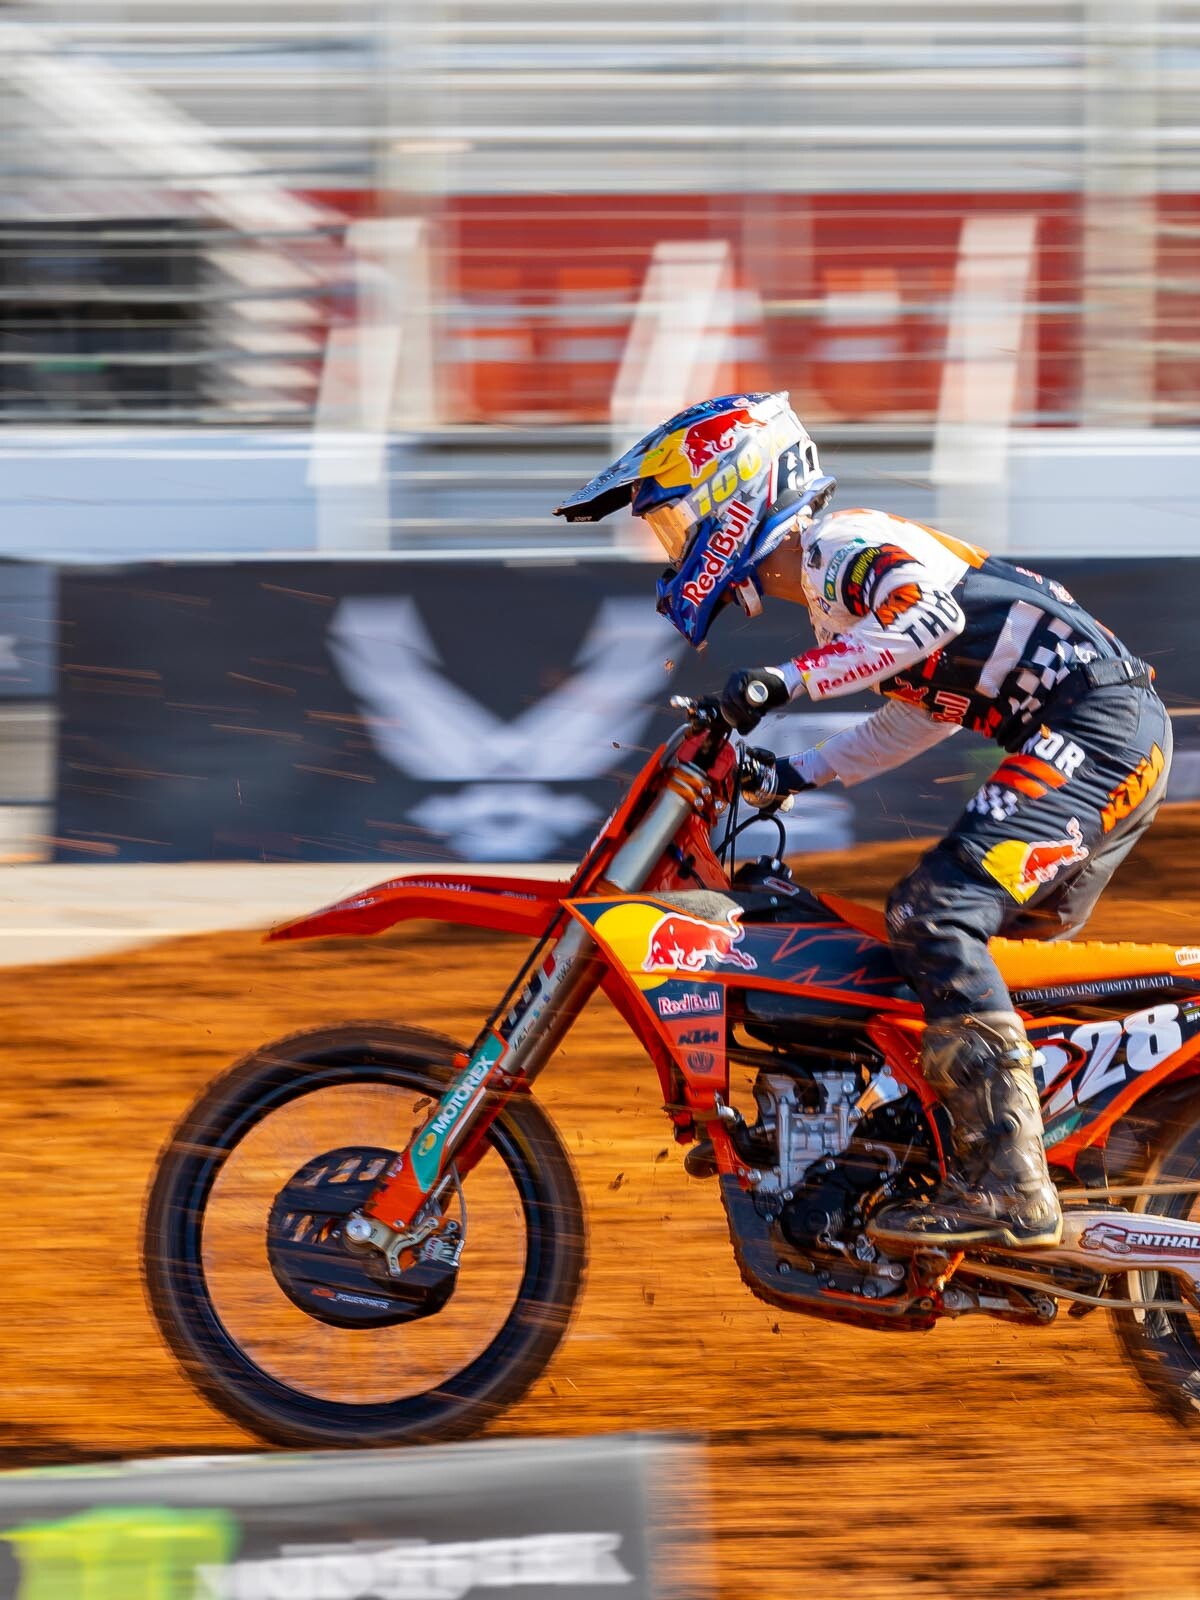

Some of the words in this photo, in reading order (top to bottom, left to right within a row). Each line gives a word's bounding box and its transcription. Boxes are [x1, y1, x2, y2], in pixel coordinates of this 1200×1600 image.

[901, 589, 960, 650] THO
[1015, 991, 1043, 1002] LOMA
[1045, 987, 1075, 999] LINDA
[1076, 980, 1133, 996] UNIVERSITY
[1134, 975, 1174, 990] HEALTH
[658, 995, 690, 1015] Red
[690, 992, 720, 1011] Bull
[678, 1029, 719, 1045] KTM
[432, 1056, 495, 1134] MOTOREX
